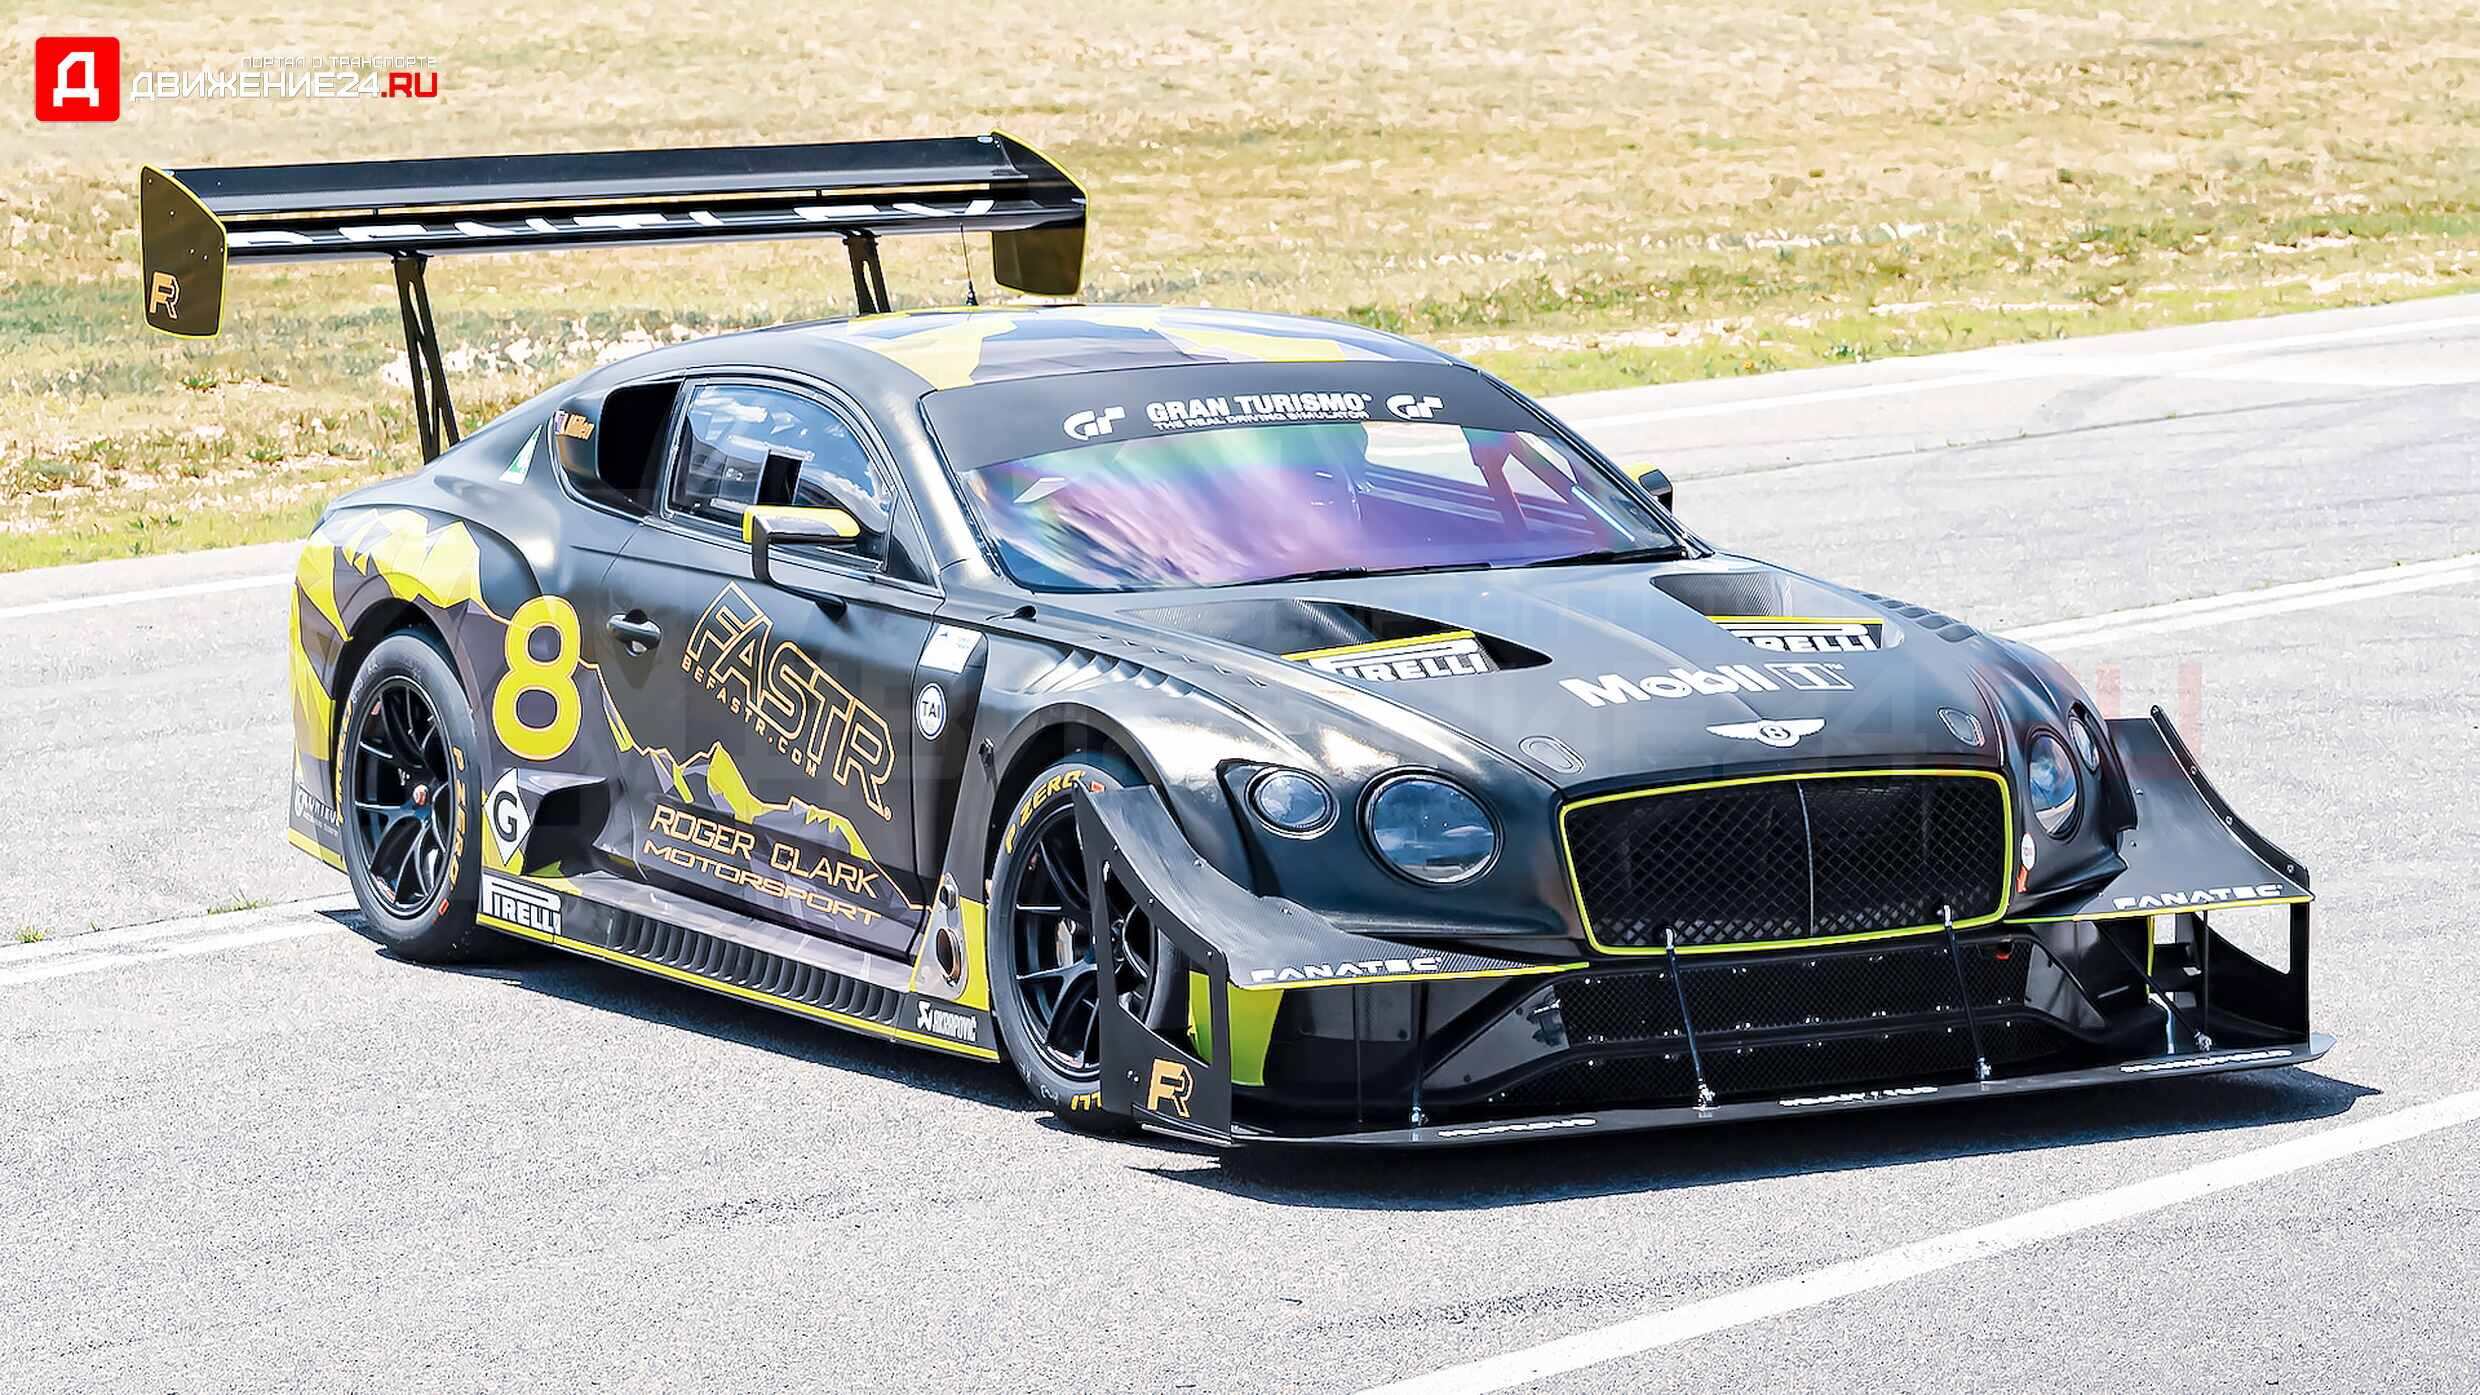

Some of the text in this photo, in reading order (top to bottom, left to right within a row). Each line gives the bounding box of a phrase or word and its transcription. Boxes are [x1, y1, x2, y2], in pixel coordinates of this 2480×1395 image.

[1146, 396, 1230, 422] GRAN
[1153, 410, 1370, 432] THE REAL DRIVING SIMULATOR
[492, 595, 582, 761] 8
[1557, 664, 1780, 707] Mobil
[681, 654, 818, 778] BEFASTR.COM
[494, 791, 519, 843] G
[650, 804, 880, 899] ROGER CLARK
[481, 874, 562, 936] PIRELLI
[643, 840, 882, 927] MOTORSPORT
[2113, 883, 2284, 911] FANATEC
[1250, 956, 1443, 985] FANATEC
